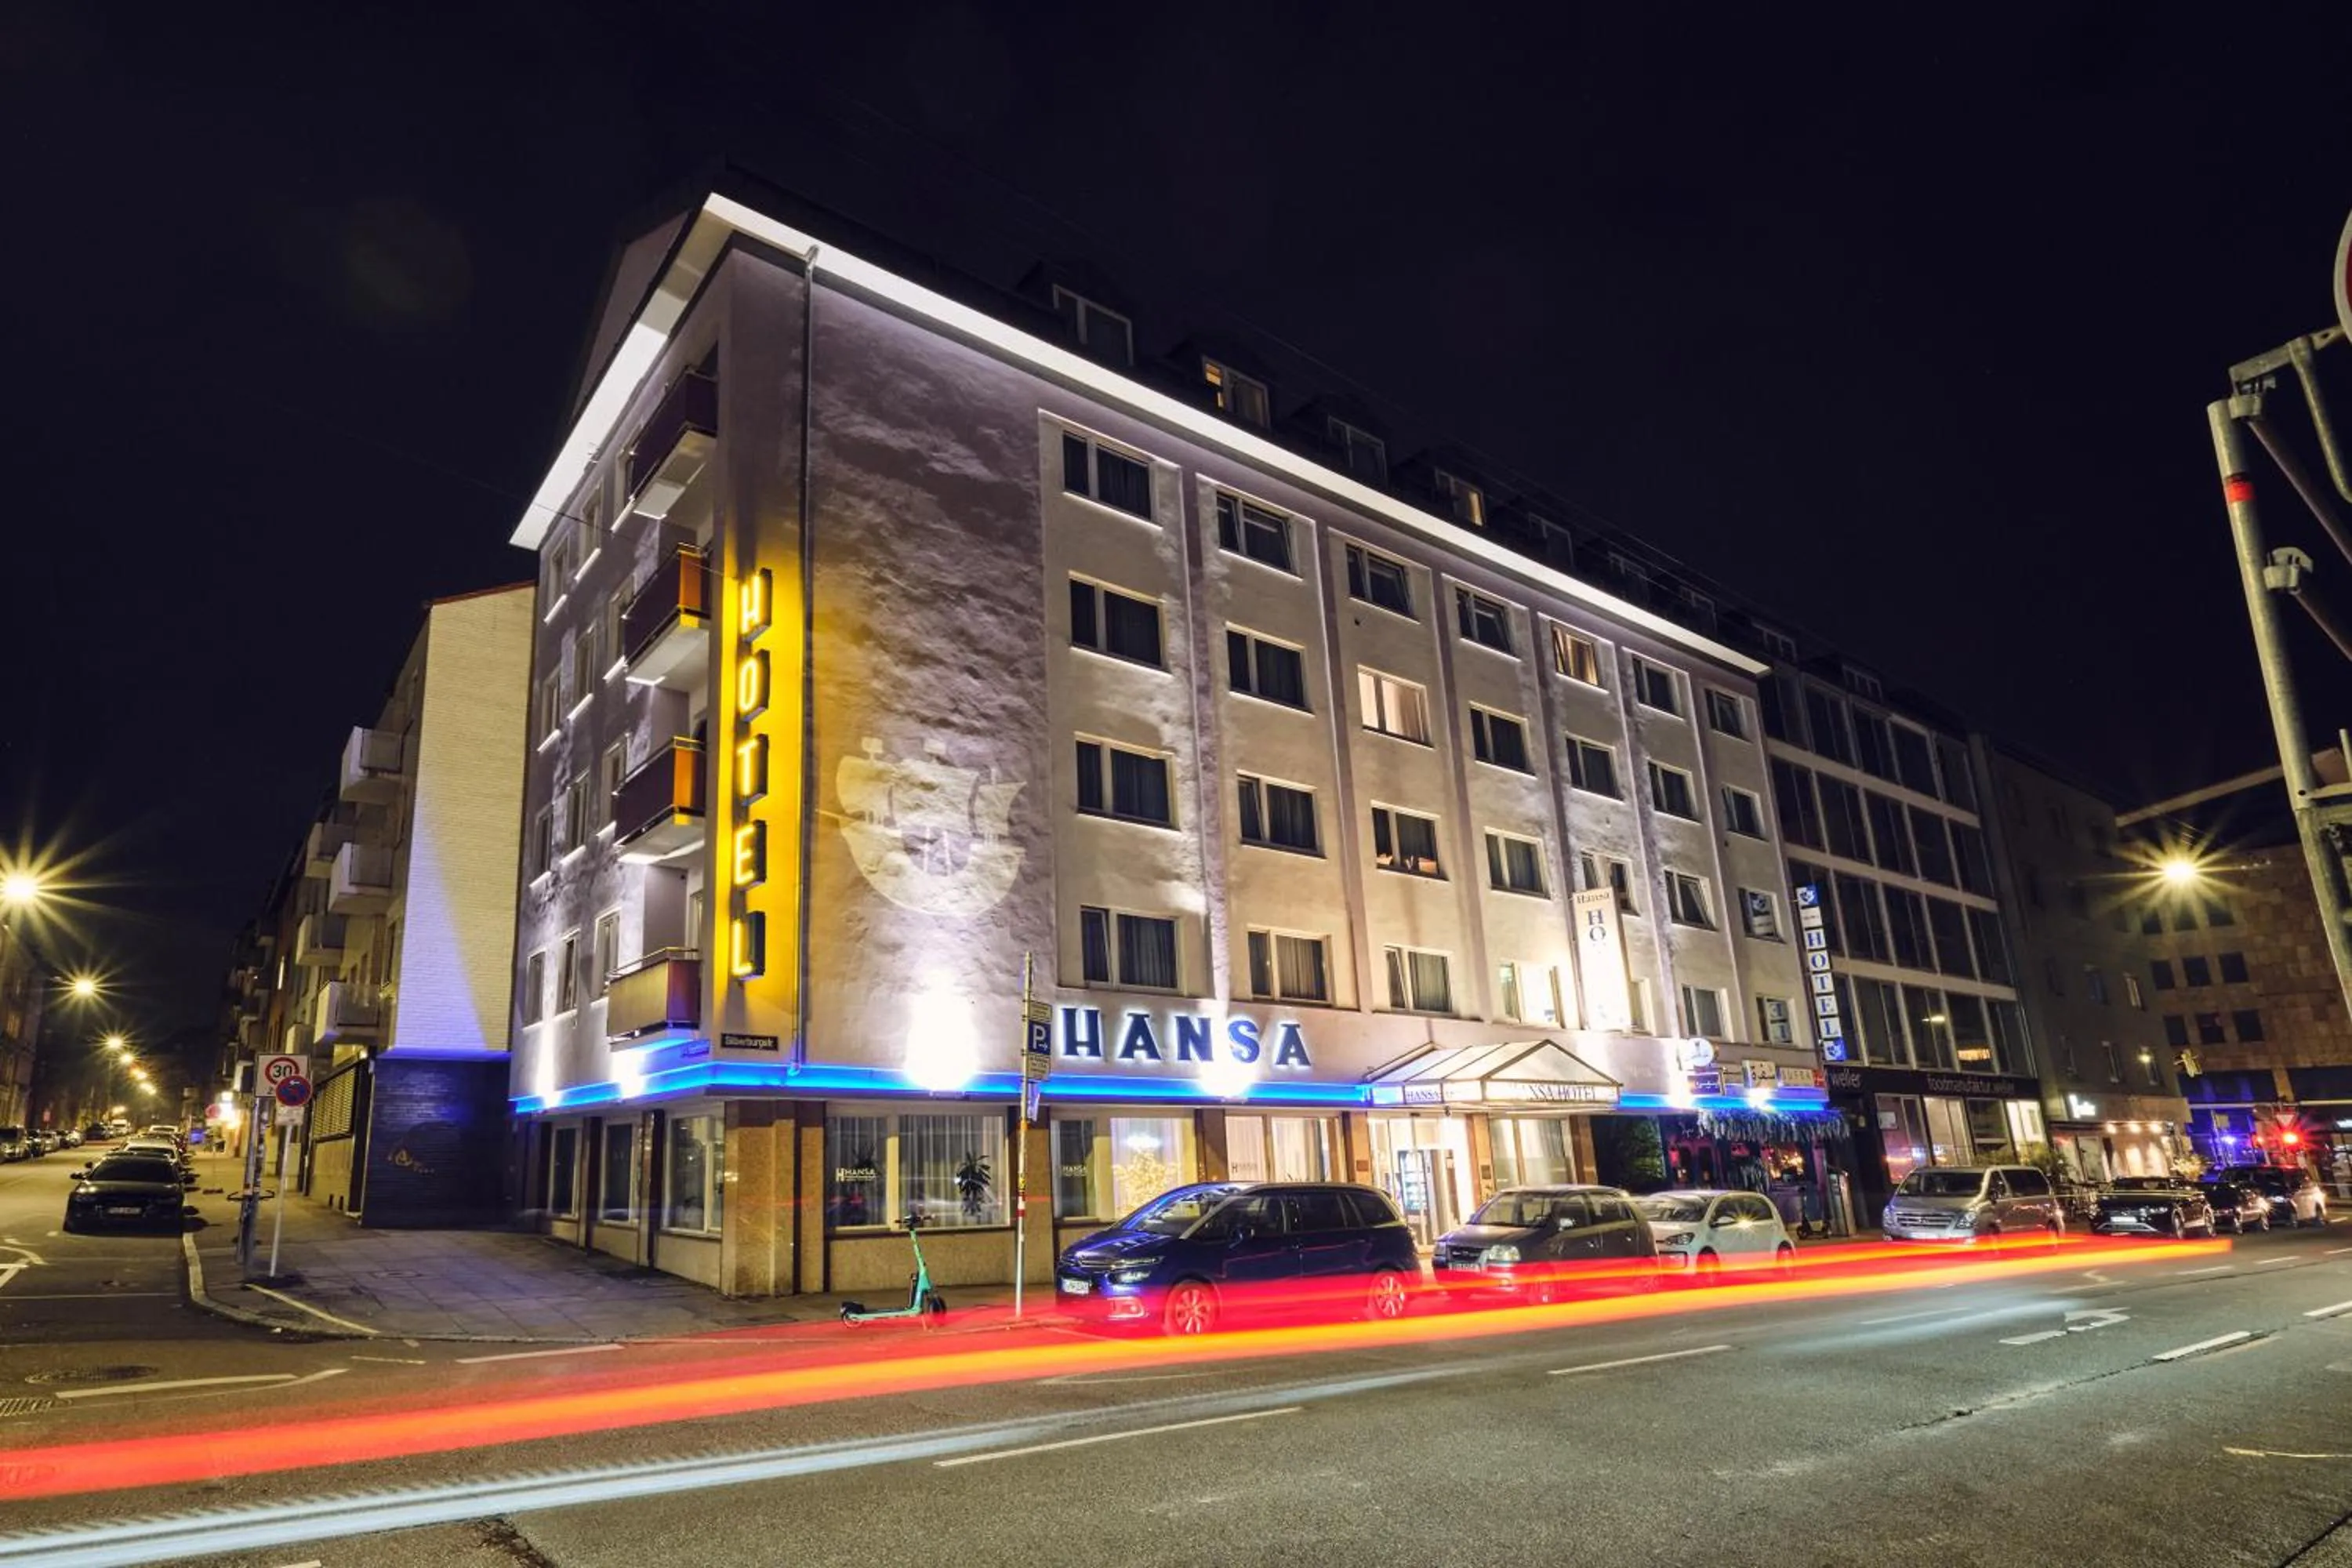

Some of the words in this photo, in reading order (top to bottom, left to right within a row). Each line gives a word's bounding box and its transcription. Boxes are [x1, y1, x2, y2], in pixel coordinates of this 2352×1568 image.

[731, 570, 769, 978] HOTEL
[1806, 931, 1839, 1036] HOTEL
[1033, 1024, 1047, 1050] P
[1060, 1007, 1312, 1067] HANSA
[273, 1065, 292, 1078] 30
